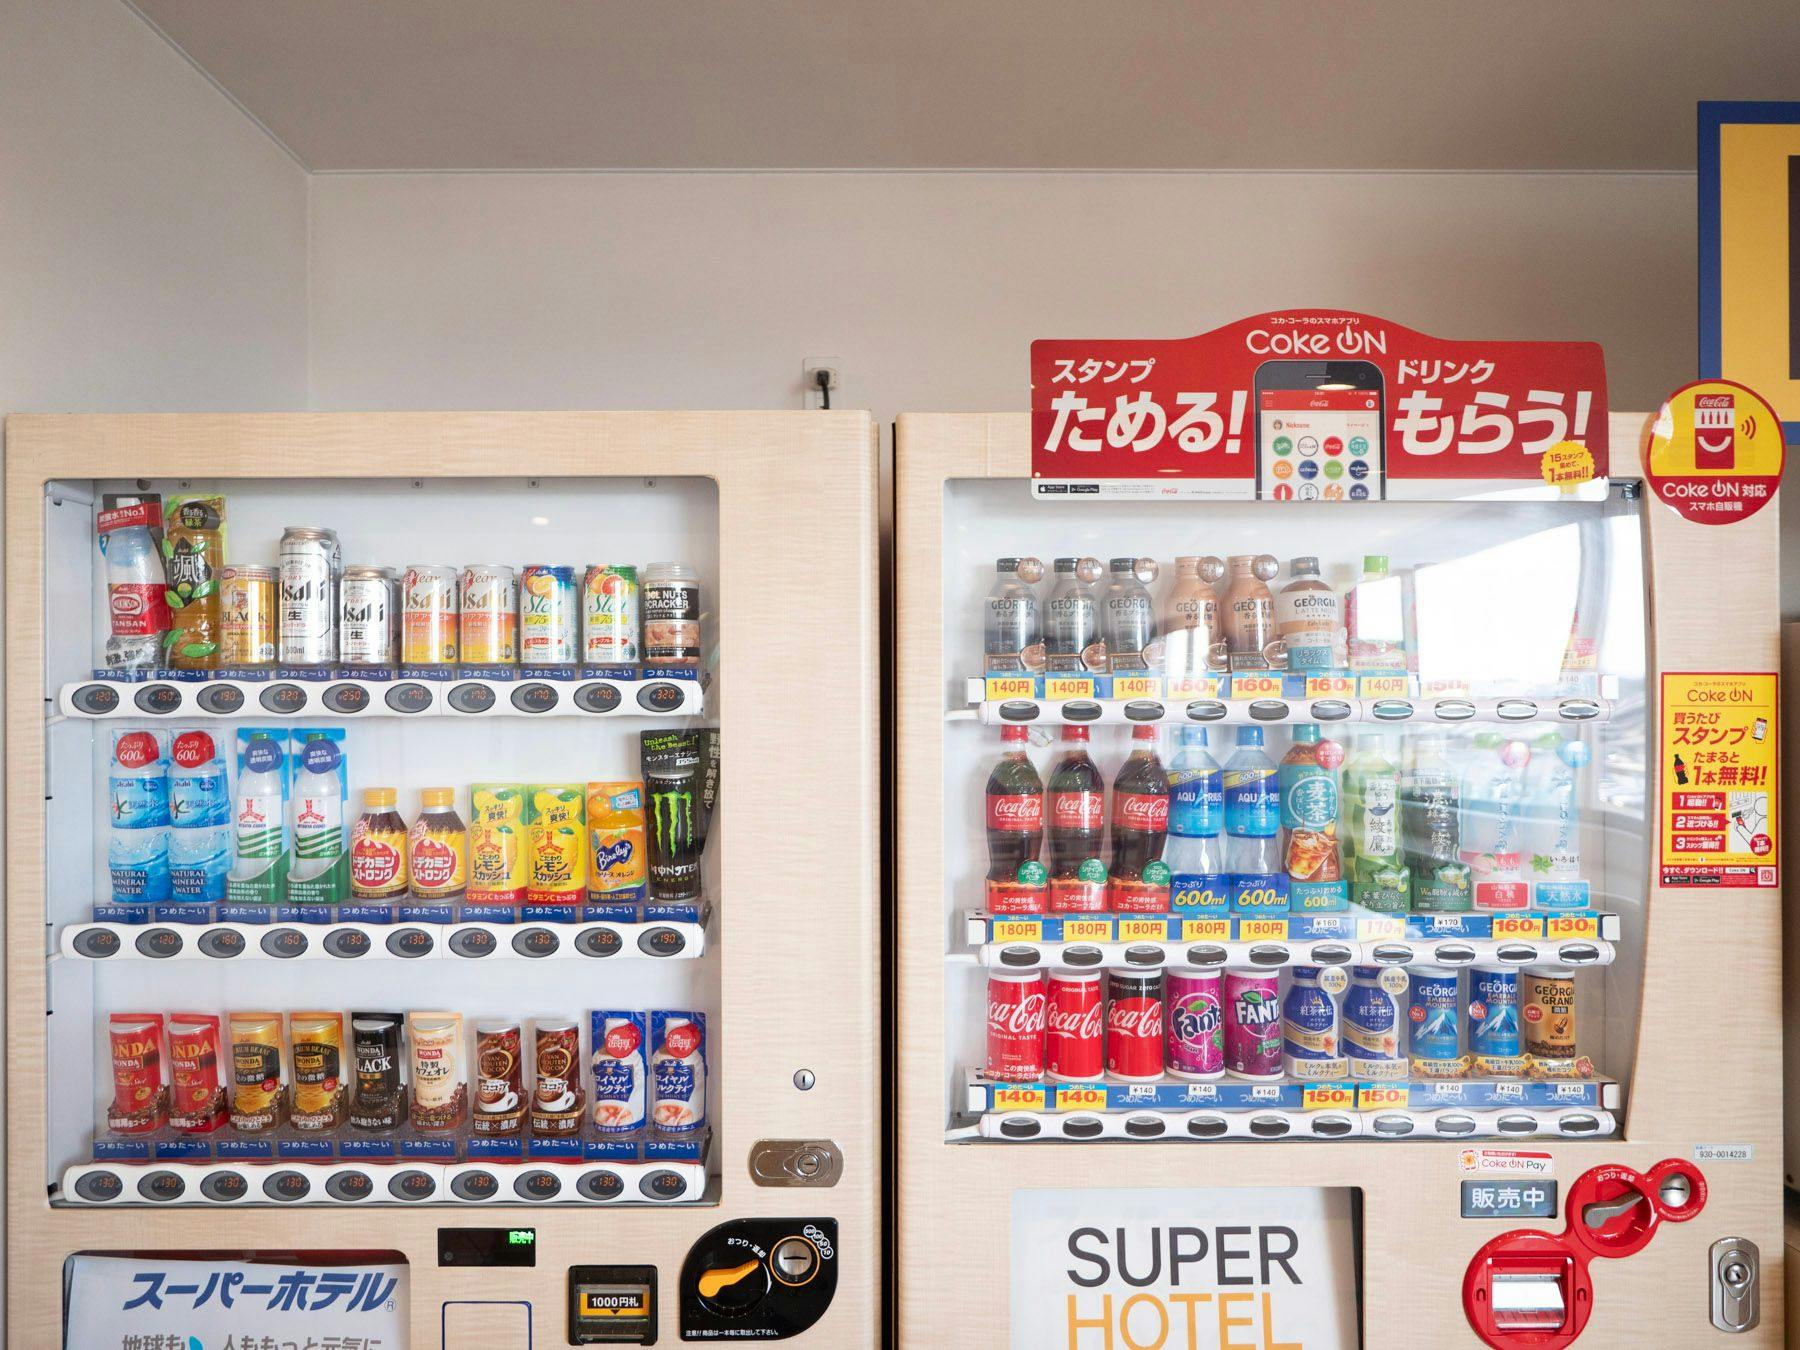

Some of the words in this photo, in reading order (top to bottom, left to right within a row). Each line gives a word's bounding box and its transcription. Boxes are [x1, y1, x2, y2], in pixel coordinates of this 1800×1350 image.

[1270, 317, 1360, 325] コカ・コーラのスマホアプリ
[1246, 329, 1331, 355] Coke
[1336, 326, 1387, 355] ON
[1052, 358, 1156, 383] スタンプ
[1397, 359, 1495, 385] ドリンク
[1699, 396, 1730, 408] Coca-Cola
[1044, 390, 1248, 454] ためる!
[1393, 390, 1592, 455] もらう!
[1550, 452, 1584, 463] 15スタンプ
[1549, 466, 1589, 482] 1本無料!!
[1663, 482, 1709, 498] Coke
[1712, 480, 1739, 498] ON
[1742, 484, 1767, 497] 対応
[1690, 501, 1743, 511] スマホ自販機
[662, 591, 688, 599] NUTS
[288, 610, 302, 621] 生
[350, 630, 364, 640] 生
[992, 680, 1029, 693] 140円
[1052, 681, 1089, 693] 140円
[1120, 680, 1156, 692] 140円
[1234, 679, 1280, 692] 160円
[1309, 679, 1354, 692] 160円
[1366, 679, 1403, 691] 140円
[1687, 689, 1726, 702] Coke
[1730, 687, 1753, 702] ON
[1673, 712, 1721, 725] 買うたび
[644, 735, 677, 746] Unleash
[1672, 726, 1749, 746] スタンプ
[121, 741, 144, 750] たっぷり
[1693, 752, 1740, 764] たまると
[1693, 765, 1768, 786] 1本無料!
[995, 798, 1040, 816] Coca-Cola
[1305, 781, 1328, 821] 麦茶
[1679, 795, 1685, 807] 1
[1675, 816, 1686, 828] 2
[1675, 837, 1685, 850] 3
[474, 860, 505, 870] レモン
[535, 861, 568, 871] レモン
[112, 870, 147, 878] NATURAL
[354, 869, 393, 880] ストロング
[473, 871, 511, 880] スカッシュ
[533, 871, 571, 881] スカッシュ
[113, 878, 146, 886] MINERAL
[1174, 880, 1203, 888] たっぷり
[1238, 880, 1266, 888] たっぷり
[116, 886, 142, 894] WATER
[1495, 890, 1515, 899] 白桃
[1547, 890, 1582, 902] 天然水
[1174, 890, 1226, 906] 600ml
[1238, 889, 1288, 906] 600ml
[1304, 897, 1337, 907] 600ml
[1000, 924, 1036, 936] 180円
[1070, 923, 1107, 935] 180円
[1126, 923, 1162, 935] 180円
[1189, 923, 1225, 934] 180円
[1247, 923, 1283, 934] 180円
[1495, 919, 1541, 932] 160円
[1550, 919, 1595, 932] 130円
[410, 934, 424, 944] 130
[535, 934, 549, 944] 130
[1300, 1005, 1333, 1016] 紅茶花伝
[1359, 1005, 1393, 1016] 紅茶花伝
[416, 1067, 449, 1076] カフェオレ
[997, 1091, 1043, 1103] 140円
[1059, 1091, 1104, 1103] 140円
[1306, 1090, 1351, 1102] 150円
[1361, 1090, 1406, 1102] 150円
[1482, 1159, 1507, 1168] Coke
[1509, 1159, 1524, 1168] ON
[1526, 1160, 1546, 1171] Pay
[162, 1177, 176, 1187] 130
[287, 1177, 301, 1187] 130
[412, 1177, 426, 1187] 130
[537, 1177, 551, 1187] 130
[663, 1177, 677, 1187] 130
[1472, 1187, 1544, 1208] 販売中
[509, 1231, 534, 1244] 販売中
[1067, 1225, 1303, 1288] SUPER
[122, 1271, 398, 1312] スーパーホテル
[592, 1297, 639, 1307] 1000円札
[1067, 1292, 1303, 1350] HOTEL
